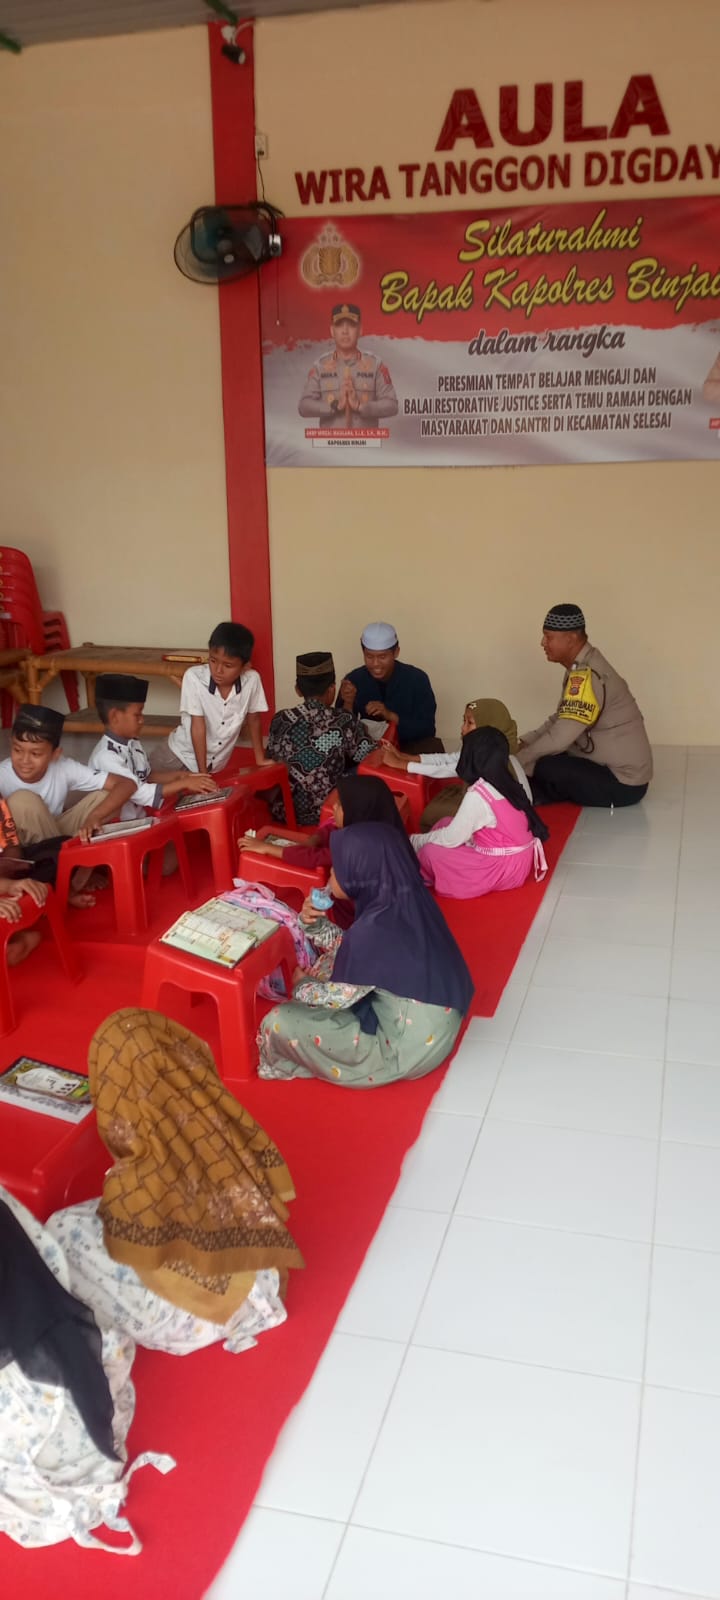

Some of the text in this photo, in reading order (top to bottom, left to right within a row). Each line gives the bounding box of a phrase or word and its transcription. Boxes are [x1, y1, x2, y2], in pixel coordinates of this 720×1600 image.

[435, 74, 670, 151] AULA
[294, 166, 390, 205] WIRA
[399, 153, 571, 198] TANGGON
[458, 208, 643, 262] Silaturahmi
[380, 269, 475, 323] Bapak
[483, 265, 614, 319] Kapolres
[468, 325, 626, 358] dalam rangka
[438, 366, 656, 392] PERESMIAN TEMPAT BELAJAR MENGAJI DAN
[404, 388, 692, 414] BALAI RESTORATIVE JUSTICE SERTA TEMU RAMAH DENGAN
[421, 411, 672, 436] MASYARAKAT DAN SANTRI DI KECAMATAN SELESAI
